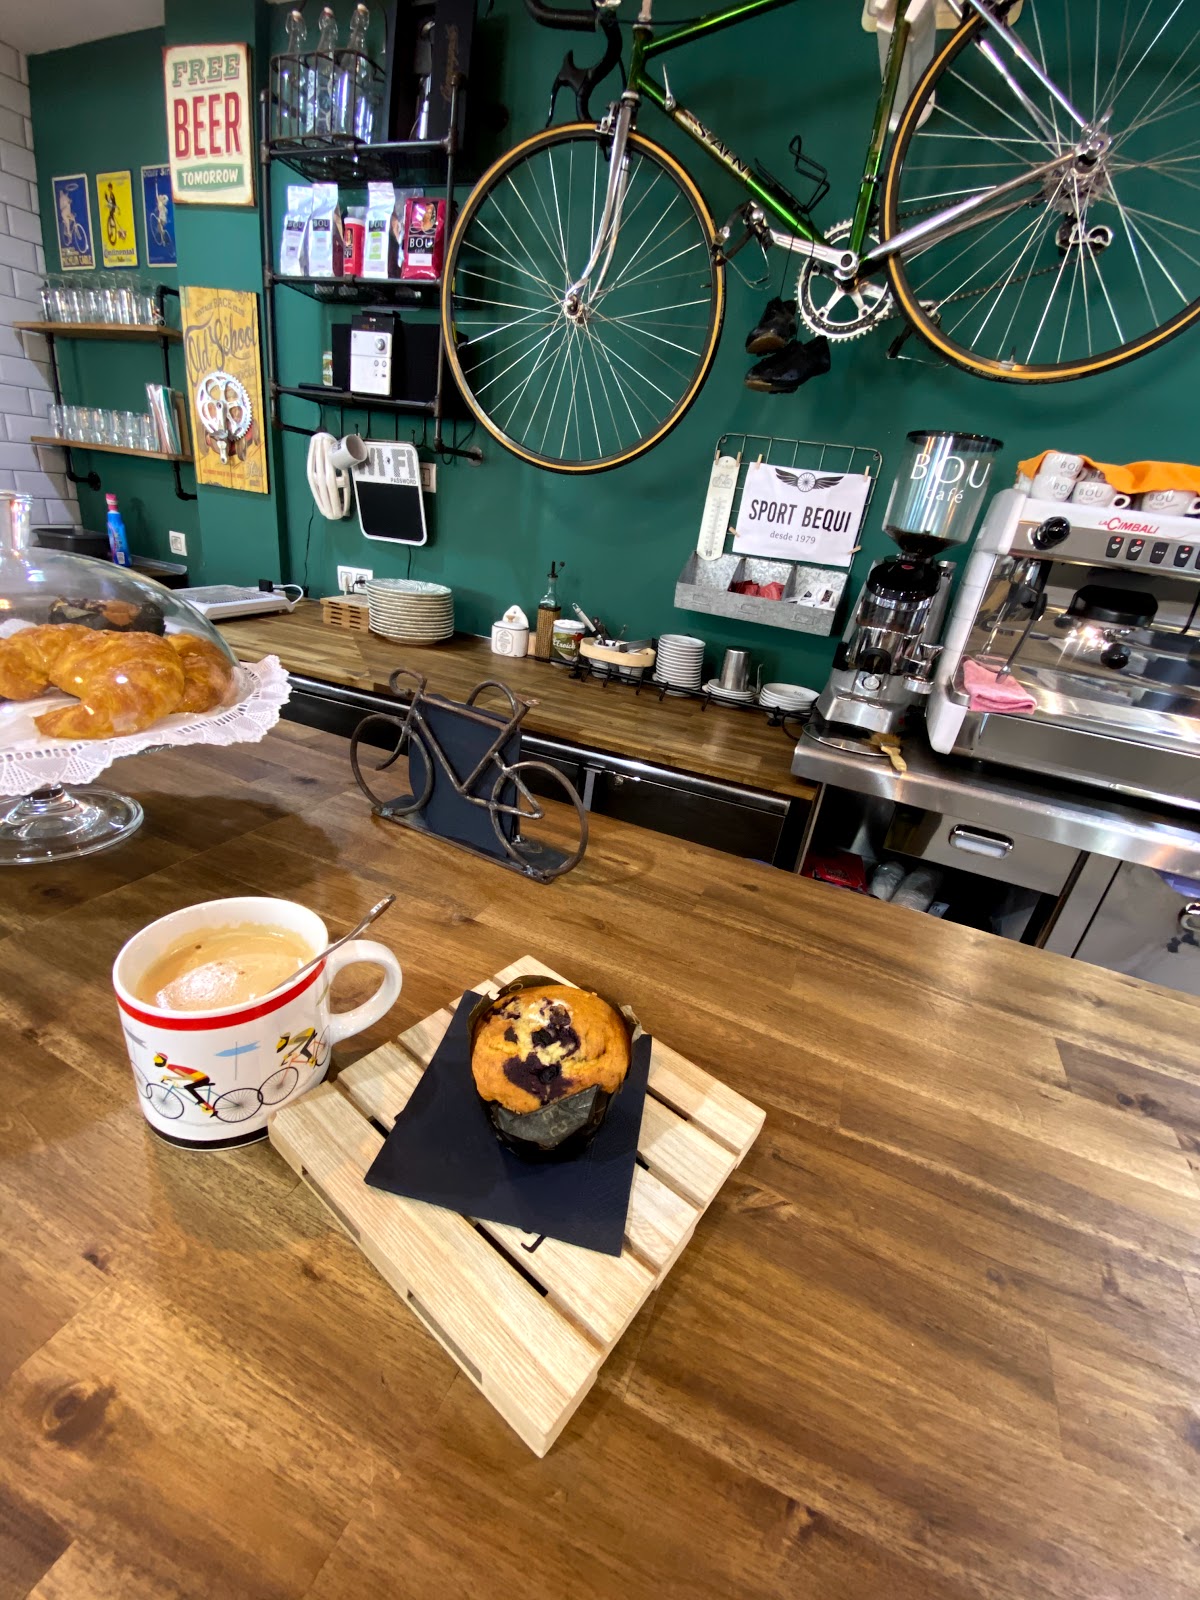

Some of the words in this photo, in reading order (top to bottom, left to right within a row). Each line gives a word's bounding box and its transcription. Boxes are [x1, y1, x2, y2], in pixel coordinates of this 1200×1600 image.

[172, 53, 241, 87] FREE
[173, 91, 241, 160] BEER
[181, 169, 239, 186] TOMORROW
[409, 237, 433, 248] BOU
[185, 311, 214, 388] Old
[208, 308, 257, 372] School
[910, 453, 991, 488] BOU
[390, 477, 417, 485] PASSWORD
[1079, 488, 1103, 498] BOU
[1149, 492, 1175, 503] BOU
[749, 499, 798, 526] SPORT
[801, 506, 852, 533] BEQUI
[1107, 517, 1160, 534] CIMBALI
[769, 530, 793, 542] desde
[795, 534, 816, 545] 1979
